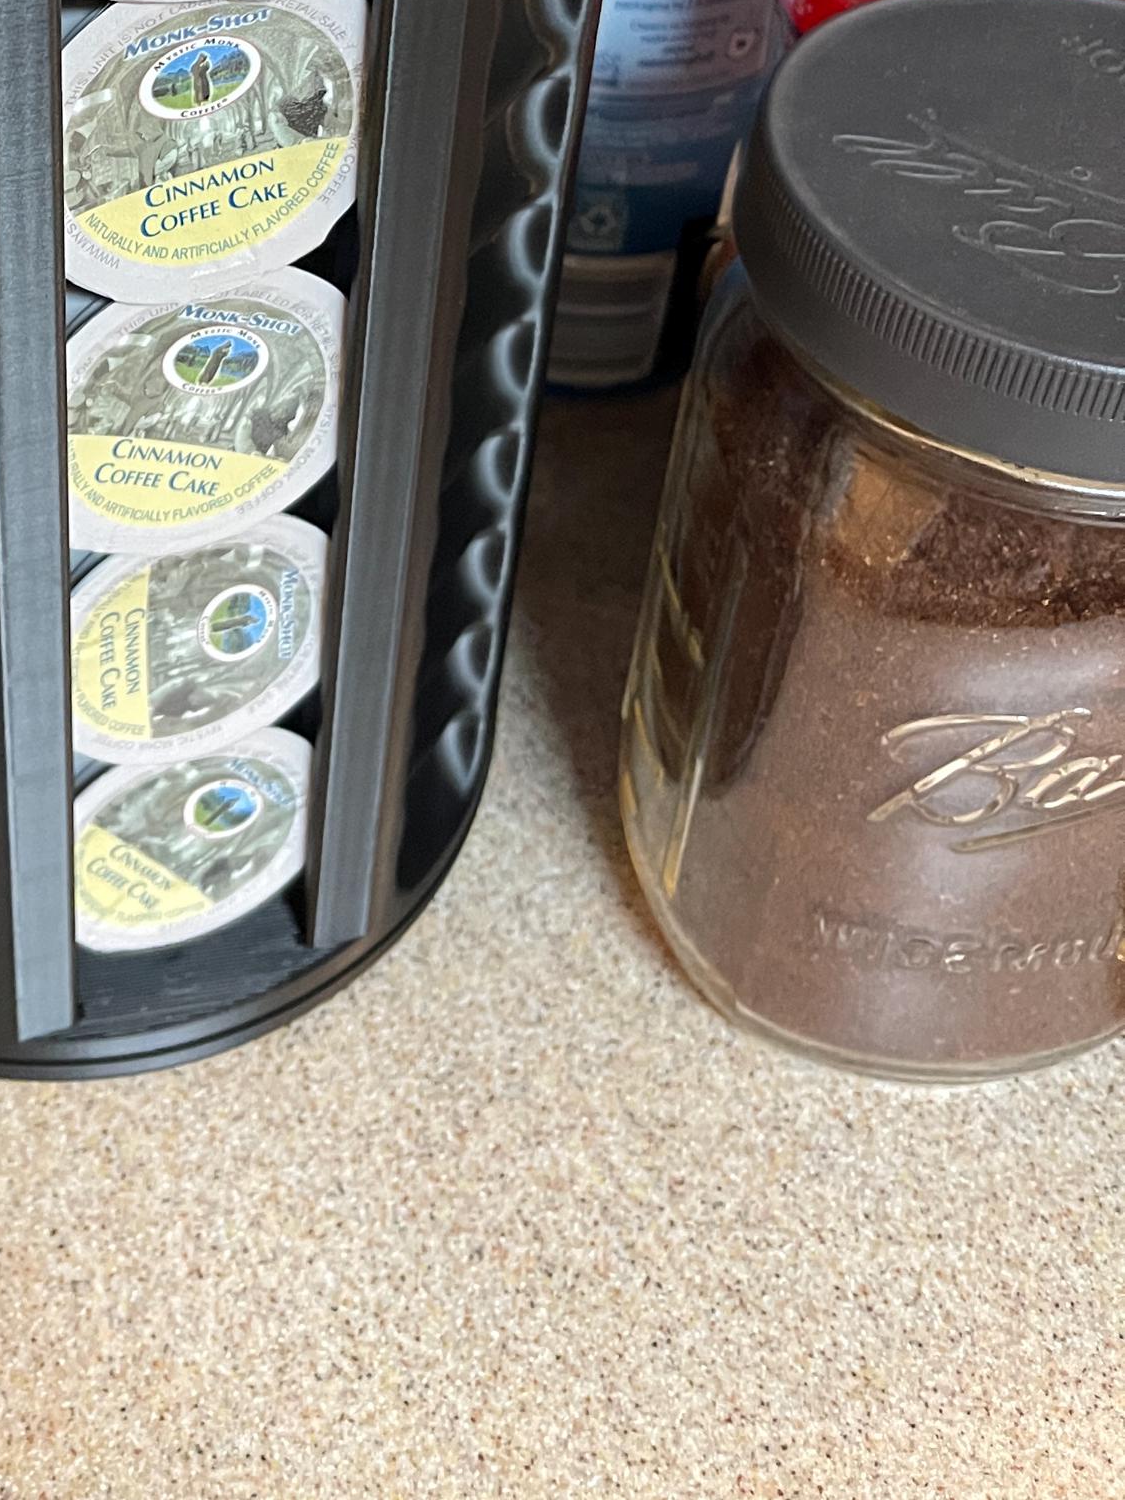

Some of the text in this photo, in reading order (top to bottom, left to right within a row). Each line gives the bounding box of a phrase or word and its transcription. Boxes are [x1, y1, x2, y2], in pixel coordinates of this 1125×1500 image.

[124, 8, 272, 60] MONK-SHOT
[319, 15, 347, 40] SALE
[65, 79, 87, 106] THIS
[88, 43, 118, 76] UNIT
[135, 14, 165, 33] NOT
[154, 39, 241, 72] MYSTIC MONK
[85, 213, 143, 254] NATURALLY
[142, 245, 169, 260] AND
[171, 229, 249, 260] ARTIFICIALLY
[251, 187, 309, 237] FLAVORED
[306, 142, 340, 188] COFFEE
[145, 158, 275, 208] CINNAMON
[317, 155, 356, 204] COFFEE
[141, 181, 288, 238] COFFEE CAKE
[178, 303, 300, 335] MONK-SHOT
[112, 438, 223, 470] CINNAMON
[84, 489, 105, 506] AND
[102, 500, 171, 521] ARTIFICIALLY
[172, 493, 233, 519] FLAVORED
[234, 463, 277, 498] COFFEE
[95, 463, 220, 497] COFFEE CAKE
[99, 611, 121, 711] COFFEE CAKE
[125, 607, 145, 695] CINNAMON
